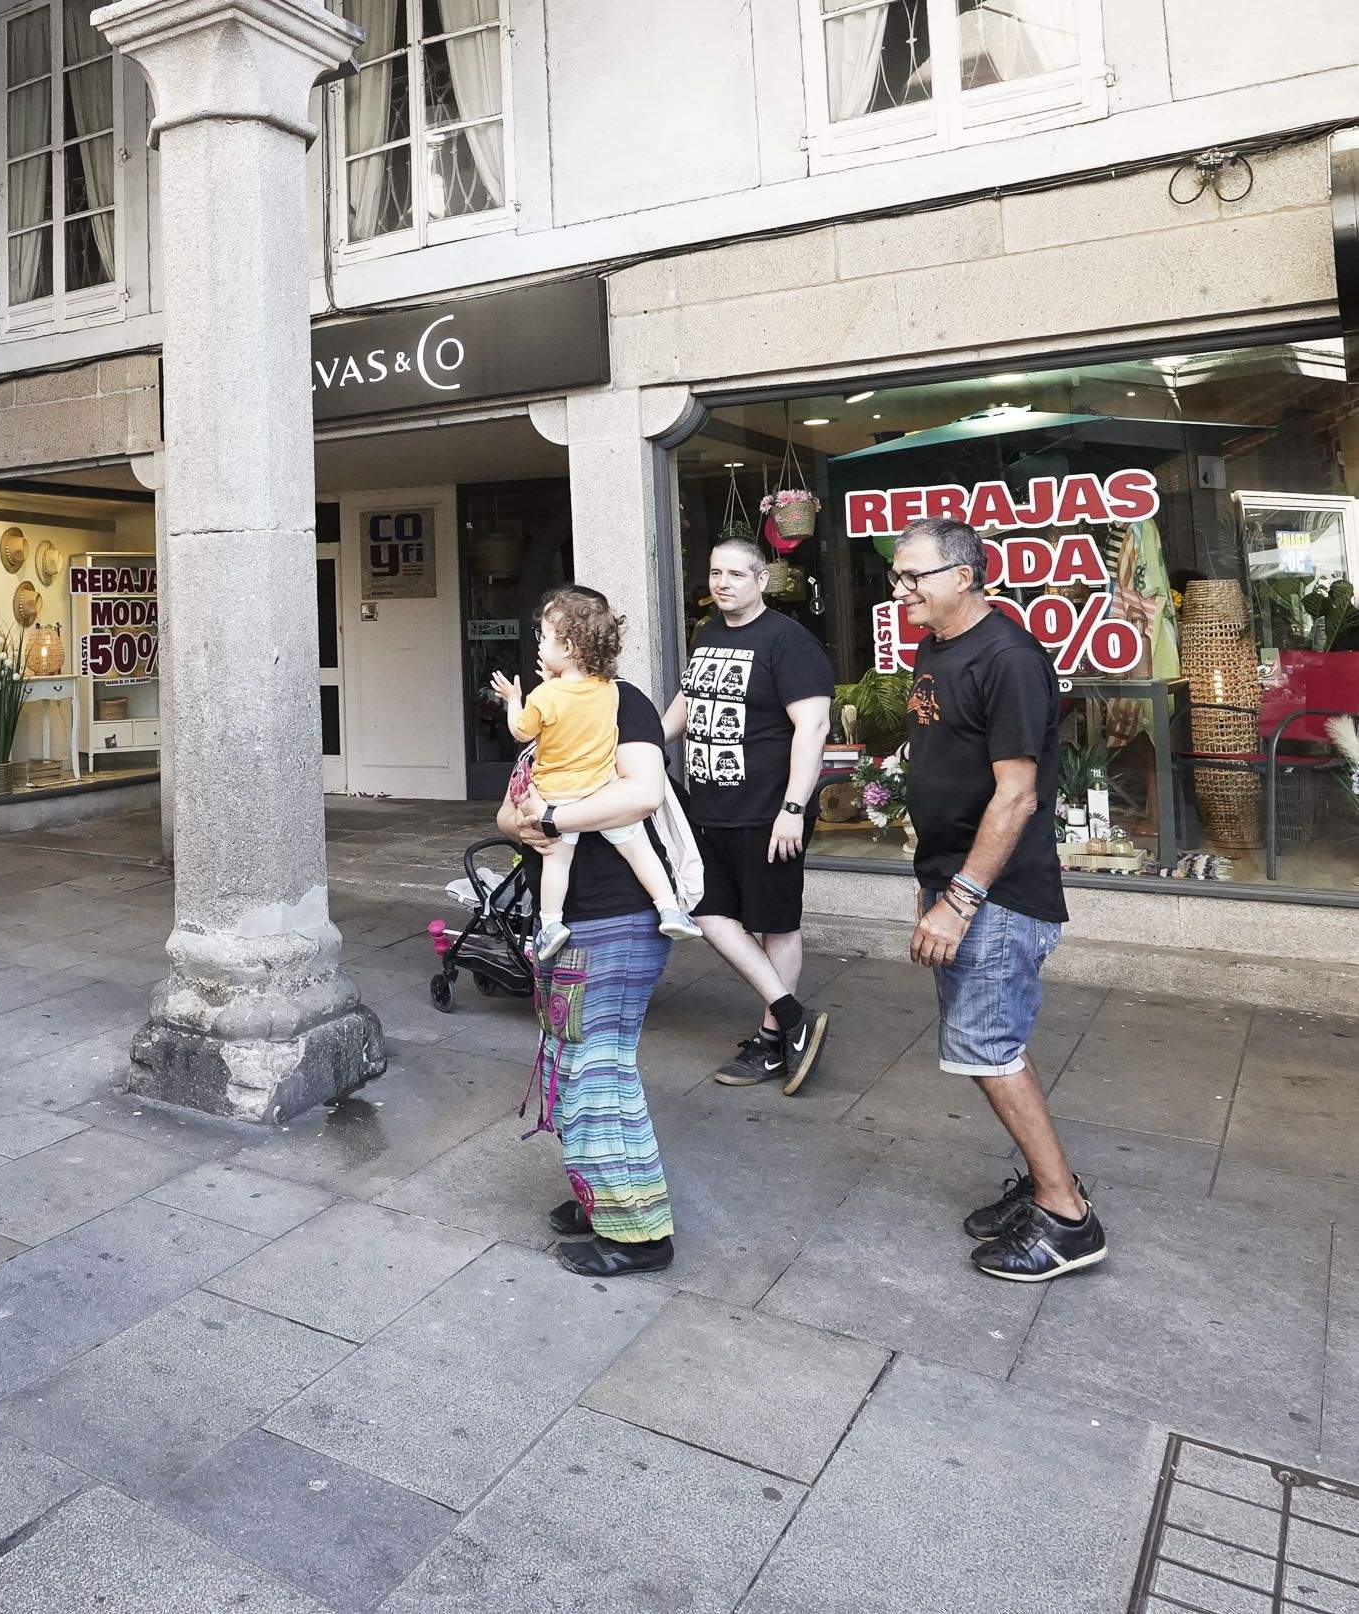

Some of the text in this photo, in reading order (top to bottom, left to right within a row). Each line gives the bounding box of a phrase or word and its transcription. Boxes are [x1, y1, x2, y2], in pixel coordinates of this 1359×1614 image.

[312, 350, 388, 391] VAS
[394, 351, 411, 373] &
[848, 472, 1156, 534] REBAJAS
[91, 601, 158, 626] MODA
[81, 636, 89, 675] HASTA
[877, 605, 894, 670] HASTA
